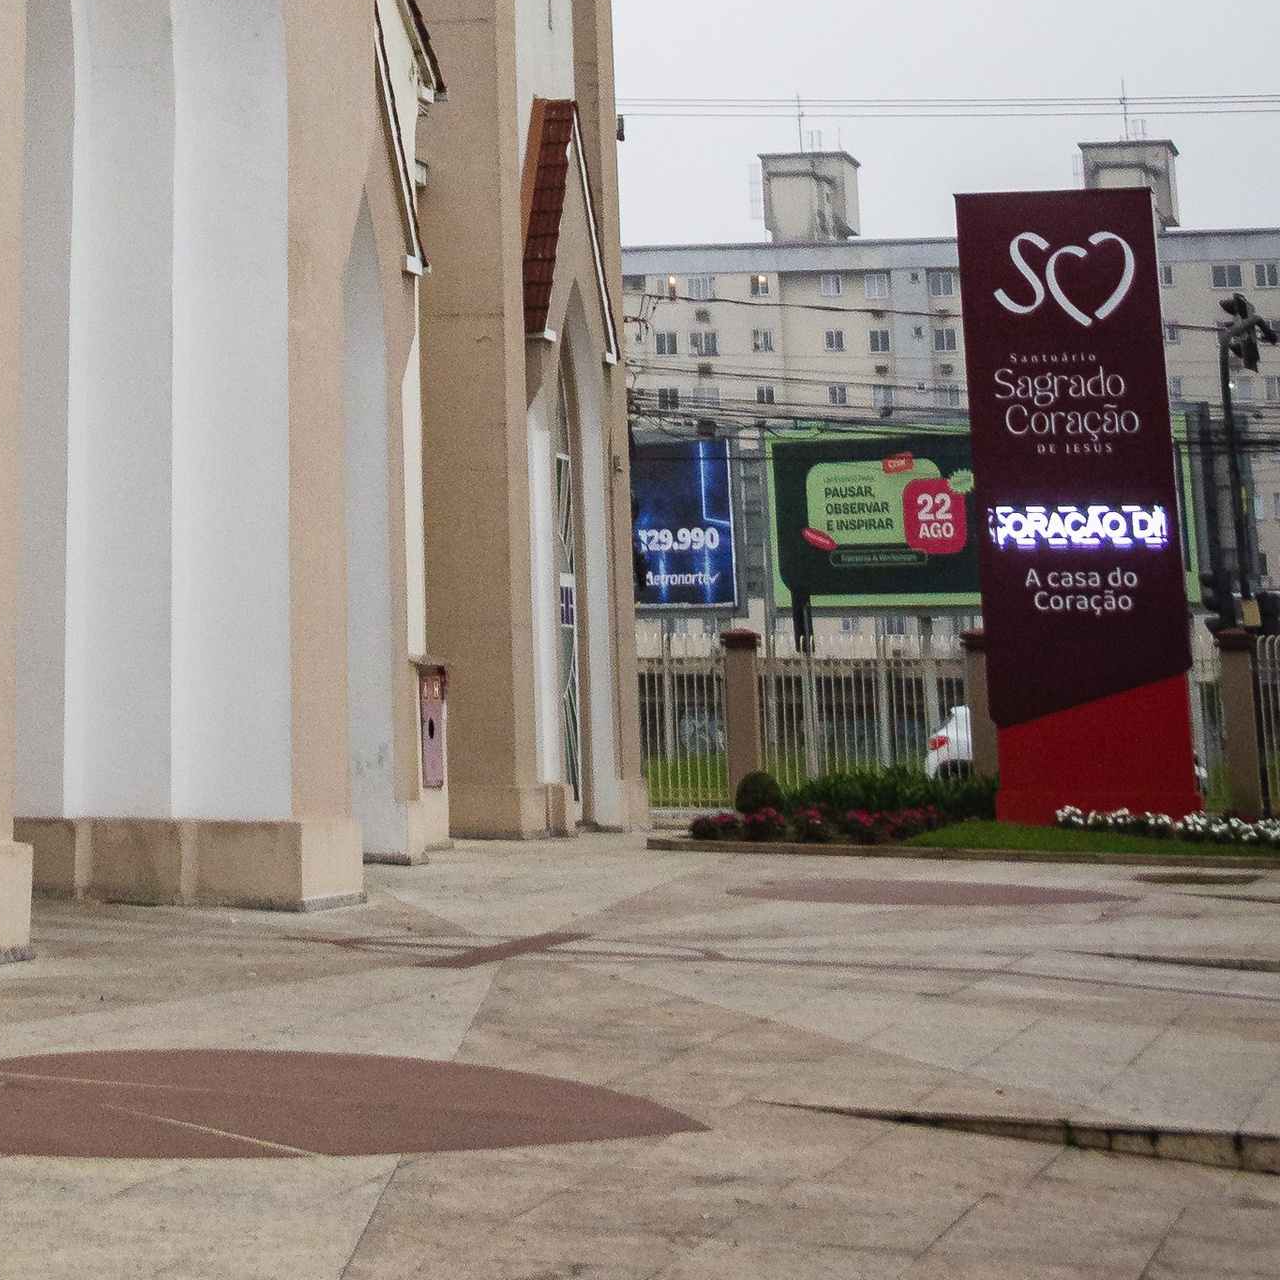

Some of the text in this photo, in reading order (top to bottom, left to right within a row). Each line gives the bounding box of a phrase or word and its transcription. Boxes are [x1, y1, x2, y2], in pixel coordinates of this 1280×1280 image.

[993, 366, 1125, 407] Sagrado
[1005, 403, 1140, 441] Coração
[1037, 443, 1056, 454] DE
[825, 502, 890, 515] OBSERVAR
[917, 493, 953, 521] 22
[826, 518, 894, 532] E INSPIRAR
[918, 523, 955, 539] AGO
[1025, 567, 1138, 588] A casa do
[1033, 590, 1133, 616] Coração
